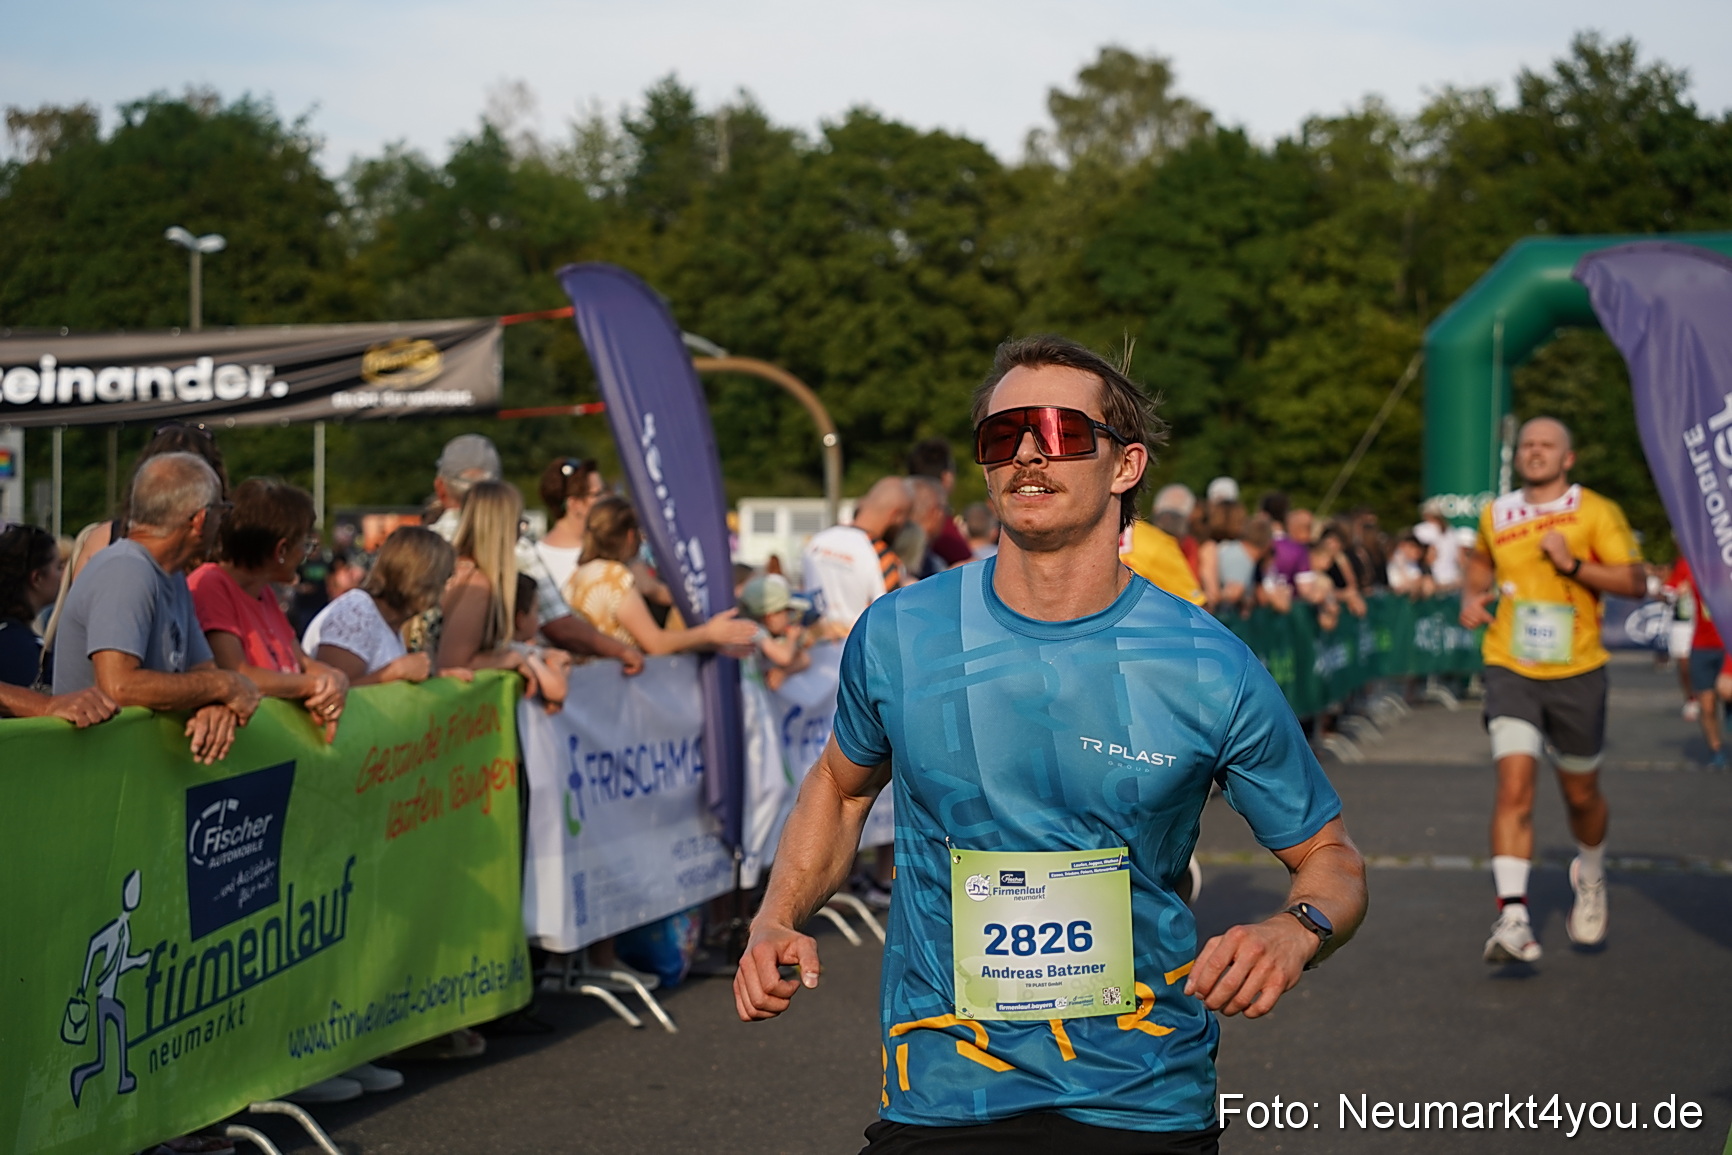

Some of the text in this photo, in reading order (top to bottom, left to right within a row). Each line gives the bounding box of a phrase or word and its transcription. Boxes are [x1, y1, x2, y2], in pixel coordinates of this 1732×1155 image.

[0, 353, 290, 405] einander.
[1079, 736, 1177, 767] TR PLAST
[1108, 760, 1150, 773] GROUP
[203, 813, 274, 856] Fischer
[208, 838, 264, 870] AUTOMOBILE
[993, 885, 1046, 895] Firmenlauf
[1014, 893, 1045, 901] neumarkt
[145, 855, 356, 1034] firmenlauf
[984, 920, 1093, 956] 2826
[981, 963, 1106, 979] Andreas Batzner
[998, 1002, 1053, 1011] firmenlauf.bayern
[149, 998, 246, 1074] neumarkt
